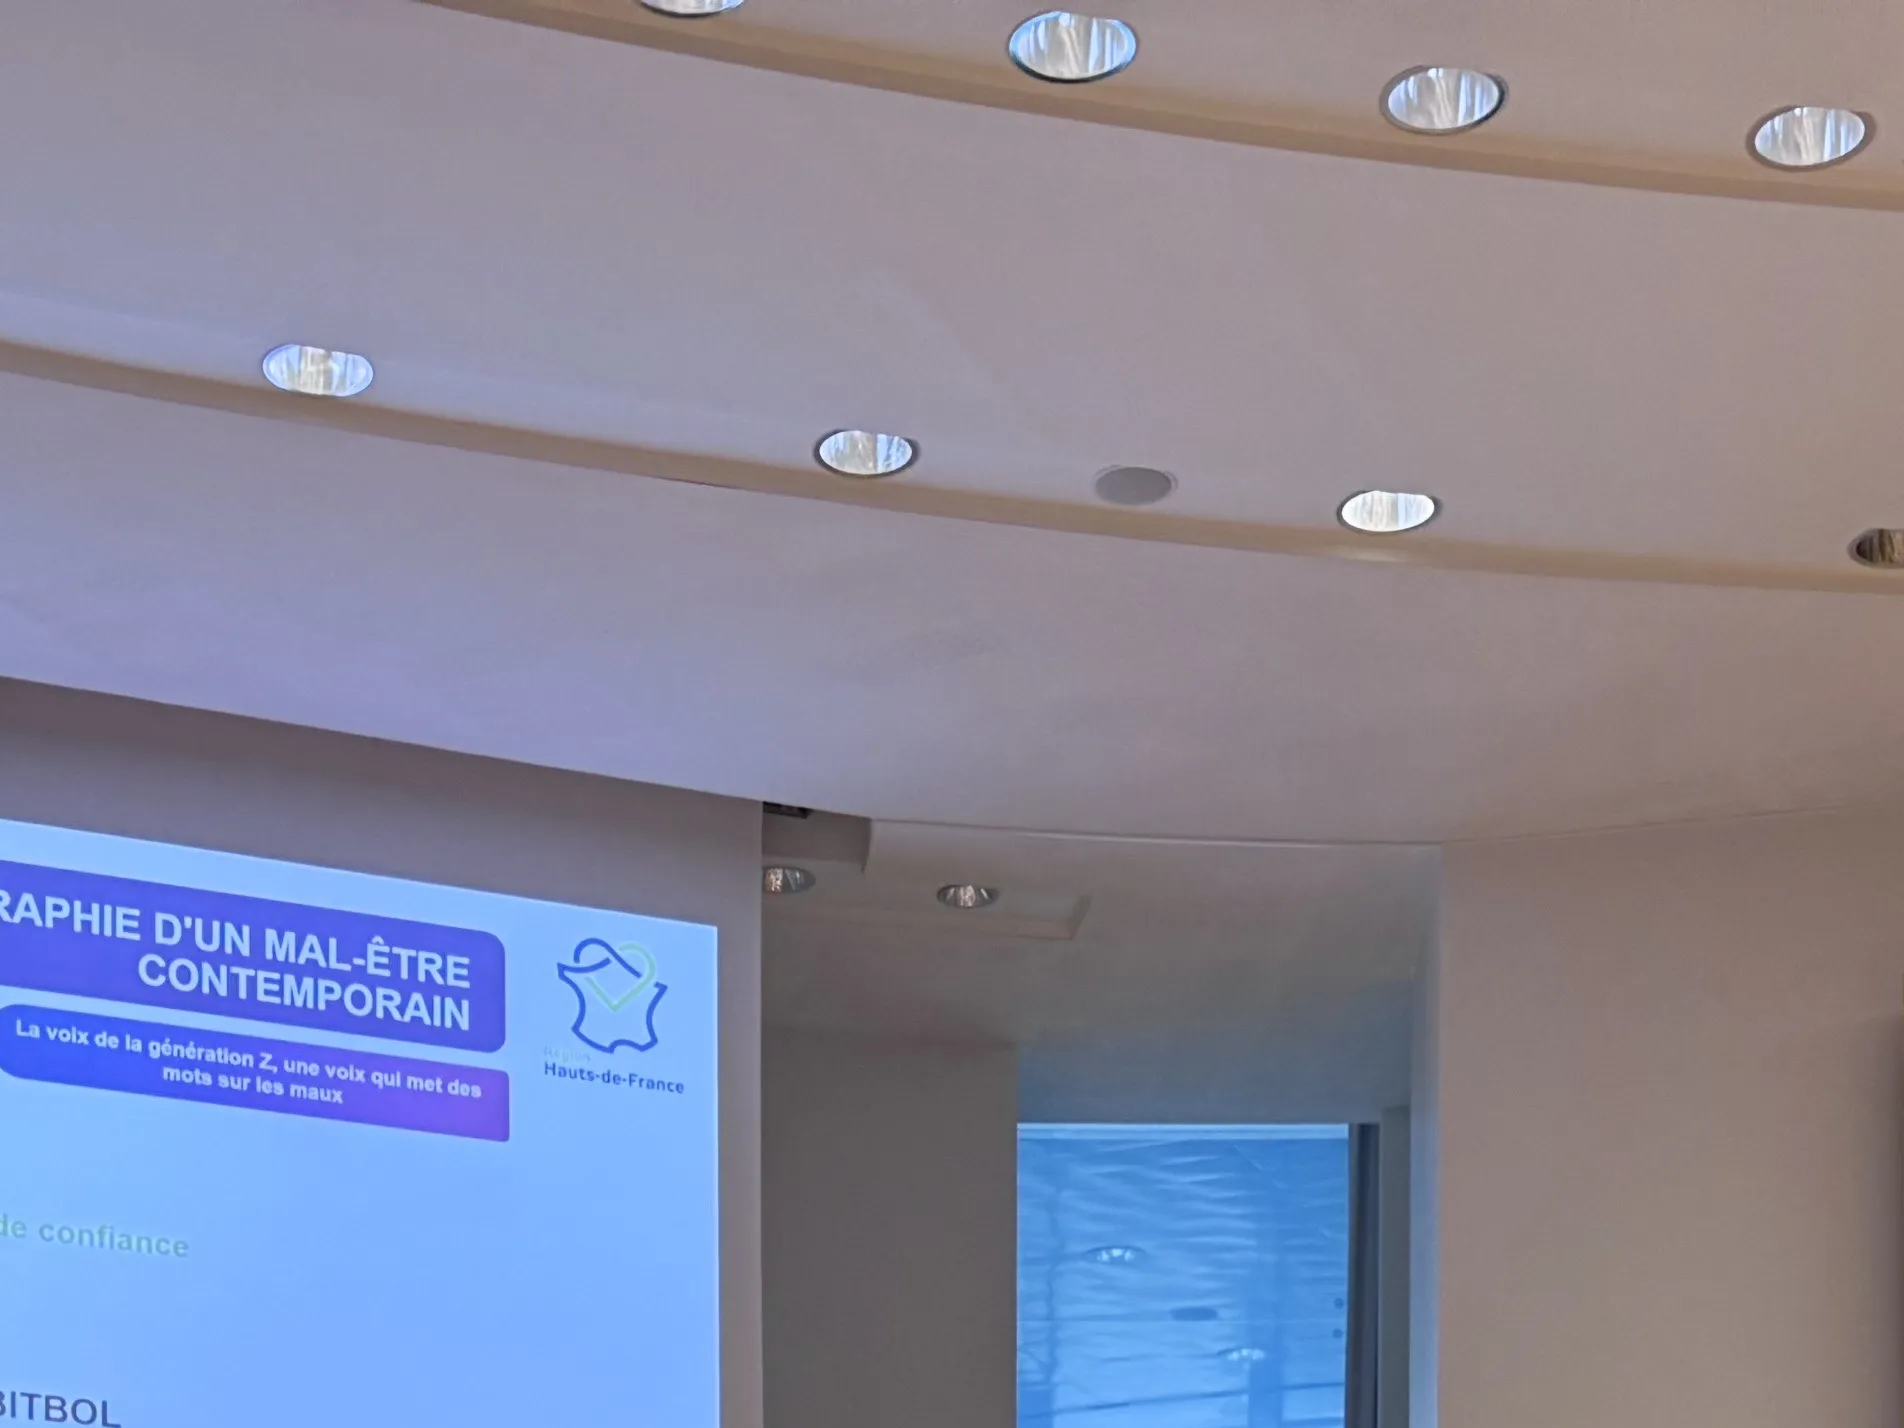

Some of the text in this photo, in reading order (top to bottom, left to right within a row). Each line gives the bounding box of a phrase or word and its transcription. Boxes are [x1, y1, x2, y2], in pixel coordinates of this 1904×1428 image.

[154, 910, 250, 957] D'UN
[265, 934, 471, 988] MAL-ÊTRE
[138, 954, 470, 1031] CONTEMPORAIN
[16, 1019, 40, 1040] La
[47, 1025, 89, 1046] voix
[94, 1031, 120, 1049] de
[125, 1034, 143, 1054] la
[149, 1036, 253, 1068] génération
[284, 1059, 319, 1078] une
[325, 1063, 365, 1084] voix
[371, 1069, 402, 1092] qui
[407, 1075, 442, 1096] met
[448, 1078, 482, 1099] des
[163, 1064, 344, 1104] mots sur les maux
[544, 1061, 684, 1094] Hauts-de-France
[39, 1222, 190, 1259] confiance
